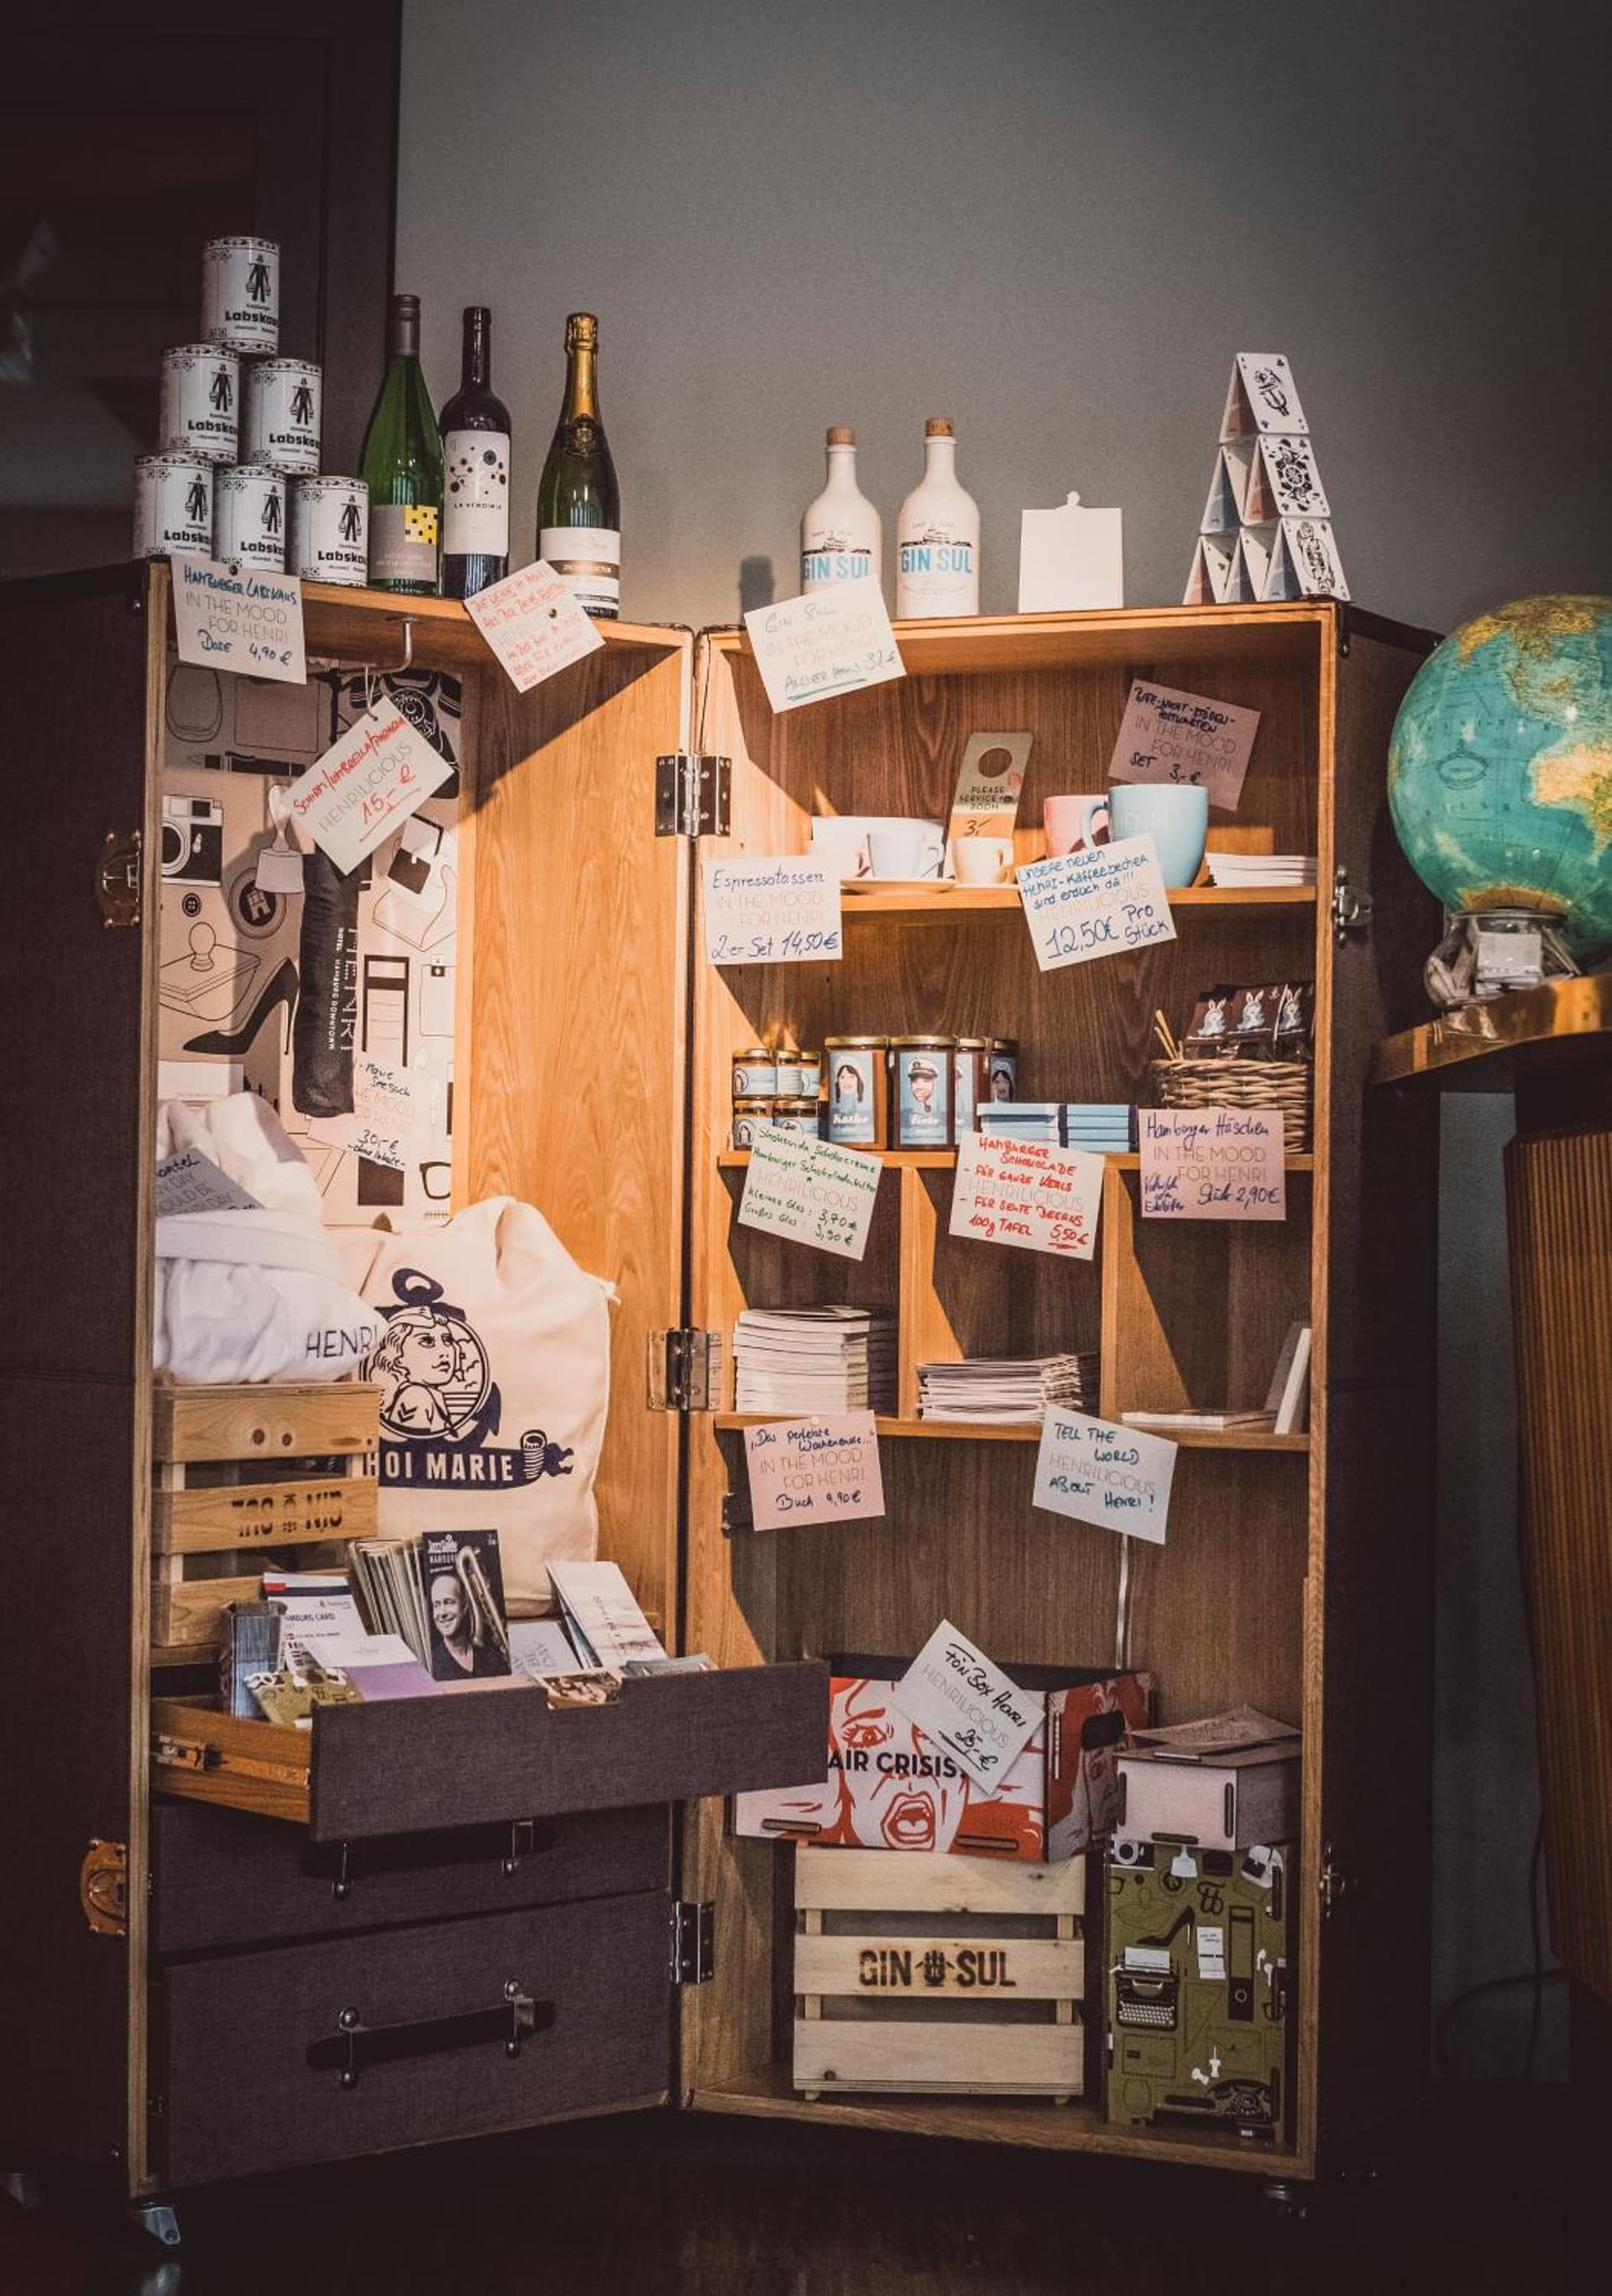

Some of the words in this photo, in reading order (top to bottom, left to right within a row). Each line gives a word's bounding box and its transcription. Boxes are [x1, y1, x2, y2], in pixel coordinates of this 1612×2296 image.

[802, 556, 830, 580] GIN
[901, 548, 930, 573] GIN
[937, 548, 973, 573] SUL
[186, 591, 200, 606] IN
[204, 594, 232, 615] THE
[237, 602, 287, 625] MOOD
[209, 615, 238, 633] FOR
[713, 864, 824, 893] Espressotassen
[332, 959, 341, 999] HAMBURG
[328, 1000, 338, 1050] DOWNTOWN
[979, 1137, 1049, 1159] HAMBURGER
[1154, 1146, 1169, 1161] IN
[1175, 1145, 1204, 1163] THE
[1210, 1146, 1266, 1163] MOOD
[1178, 1166, 1209, 1180] FOR
[1215, 1166, 1266, 1182] HENRI
[1000, 1218, 1033, 1236] TAFEL
[306, 1325, 379, 1359] HENRI
[1055, 1422, 1081, 1441] TELL
[1088, 1427, 1117, 1444] THE
[427, 1452, 514, 1481] MARIE
[760, 1459, 776, 1474] IN
[781, 1455, 806, 1472] THE
[811, 1447, 862, 1467] MOOD
[1094, 1448, 1139, 1465] WORLD
[783, 1473, 814, 1490] FOR
[818, 1467, 865, 1487] HENRI
[776, 1493, 814, 1511] Buch
[1105, 1491, 1141, 1509] HENRI
[924, 1663, 1008, 1749] HENRILICIOUS
[829, 1749, 868, 1772] AIR
[859, 1949, 912, 1986] GIN
[955, 1949, 1017, 1987] SUL
